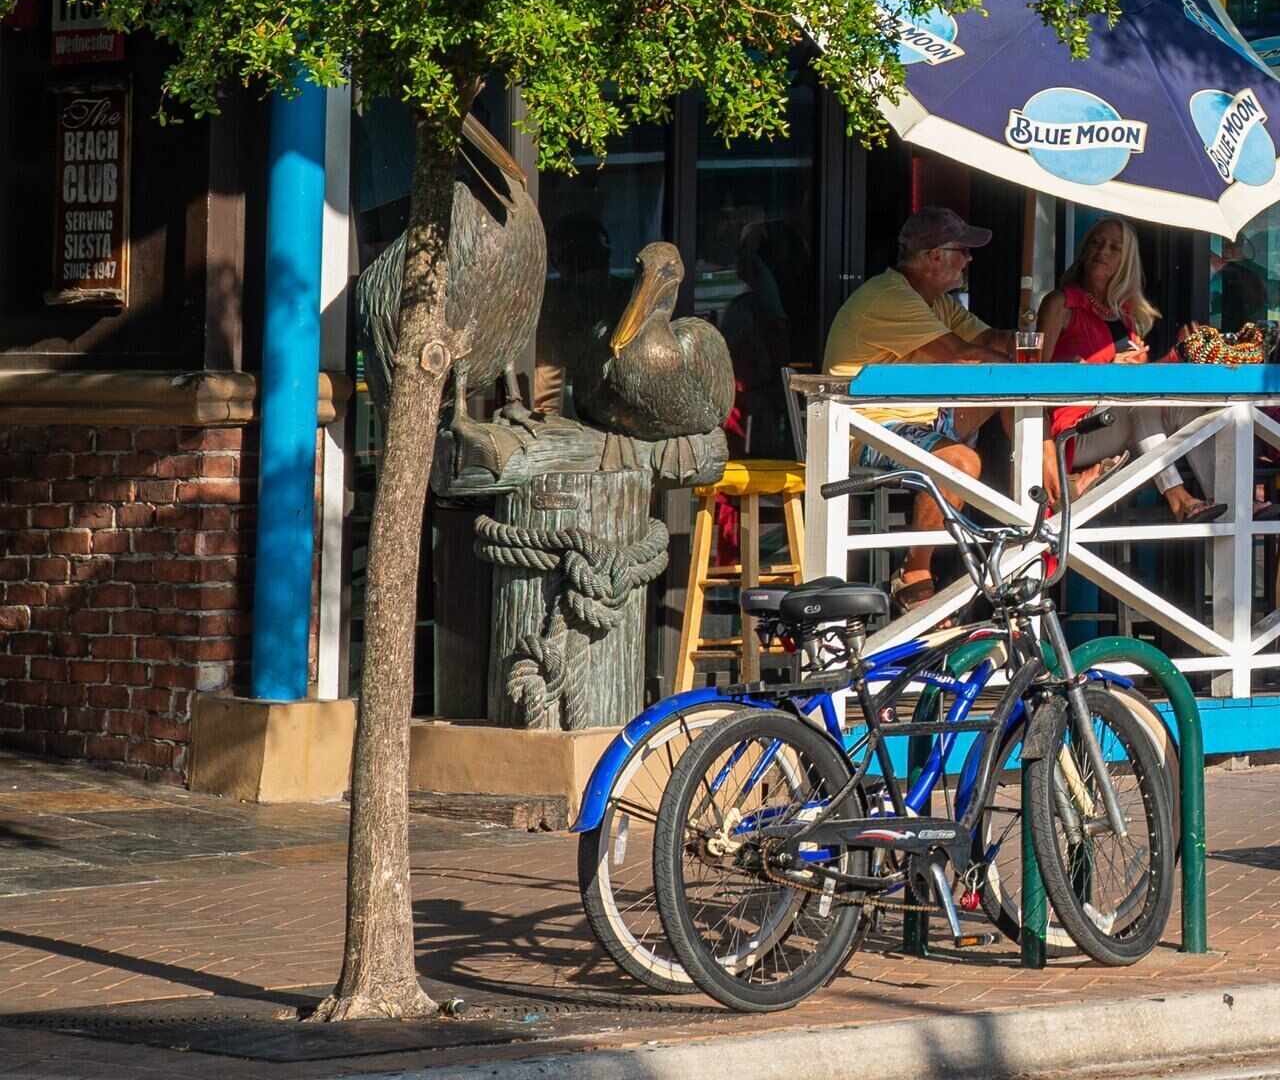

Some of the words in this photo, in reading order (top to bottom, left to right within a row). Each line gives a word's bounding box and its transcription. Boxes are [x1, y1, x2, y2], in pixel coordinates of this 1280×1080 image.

[56, 33, 114, 54] Wednesday
[901, 27, 956, 59] MOON
[62, 98, 121, 129] The
[1222, 95, 1259, 144] MOON
[64, 129, 118, 162] BEACH
[1010, 116, 1071, 145] BLUE
[1076, 124, 1141, 145] MOON
[1209, 133, 1236, 179] BLUE
[63, 163, 118, 204] CLUB
[65, 209, 114, 232] SERVING
[64, 233, 112, 261] SIESTA
[63, 262, 91, 280] SINCE
[93, 261, 117, 280] 1947
